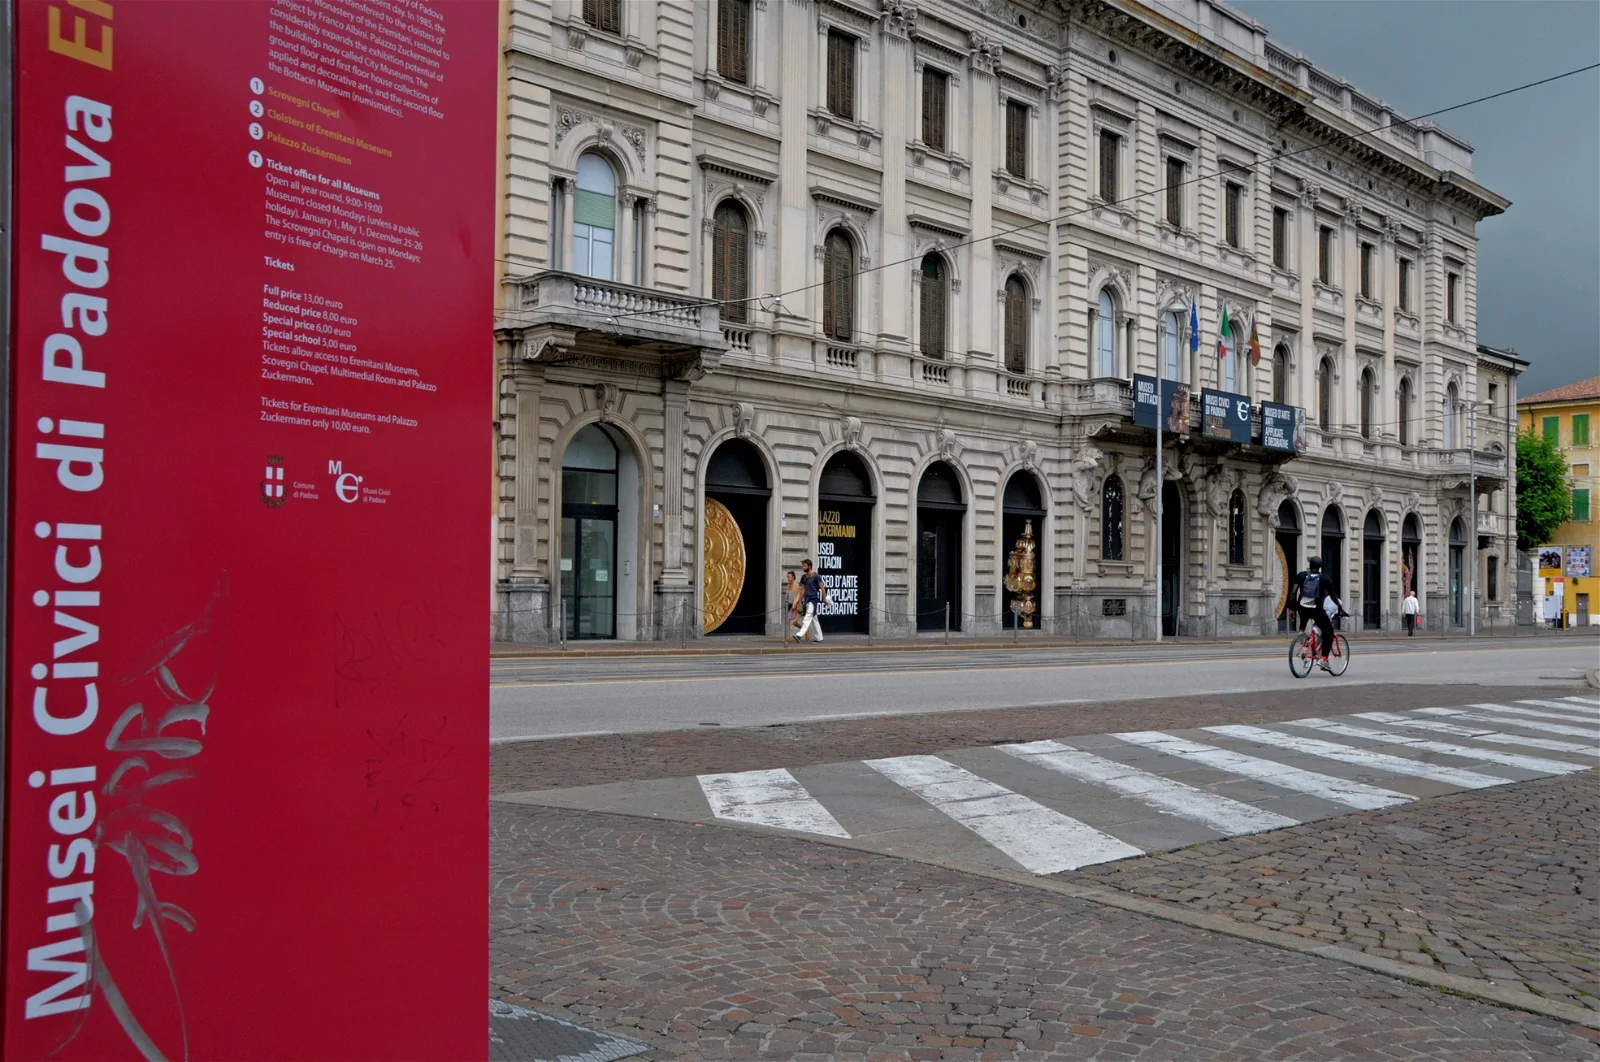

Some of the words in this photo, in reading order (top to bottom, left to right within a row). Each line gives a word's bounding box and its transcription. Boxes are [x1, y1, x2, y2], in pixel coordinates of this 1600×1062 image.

[270, 8, 321, 34] considerably
[321, 29, 354, 46] expands
[354, 41, 368, 52] the
[368, 48, 404, 66] exhibition
[405, 62, 436, 79] potential
[270, 20, 284, 32] the
[284, 26, 322, 48] buildings
[322, 43, 341, 54] now
[340, 50, 364, 64] called
[364, 57, 379, 71] City
[416, 77, 429, 89] The
[268, 62, 282, 73] the
[283, 67, 317, 86] Bottacin
[317, 80, 351, 98] Museum
[269, 36, 299, 52] ground
[300, 45, 319, 59] floor
[320, 55, 336, 66] and
[336, 59, 351, 72] first
[352, 65, 370, 78] floor
[370, 72, 393, 88] house
[393, 84, 430, 102] collections
[269, 50, 299, 66] applied
[300, 62, 316, 72] and
[316, 67, 357, 87] decorative
[374, 89, 389, 99] and
[389, 93, 402, 104] the
[403, 100, 428, 113] second
[428, 107, 444, 119] floor
[268, 86, 310, 108] Scrovegni
[310, 102, 340, 118] Chapel
[267, 109, 305, 128] Cloisters
[305, 123, 315, 132] of
[315, 125, 355, 145] Eremitani
[356, 139, 392, 157] Museums
[267, 131, 300, 148] Palazzo
[301, 142, 352, 165] Zuckermann
[266, 159, 293, 174] Ticket
[294, 169, 317, 181] office
[318, 174, 330, 185] for
[331, 180, 342, 188] all
[343, 182, 380, 200] Museums
[266, 173, 289, 186] Open
[290, 181, 300, 190] all
[301, 185, 319, 195] year
[319, 190, 344, 203] round,
[345, 196, 383, 214] 9:00-19:00
[265, 200, 300, 218] holiday),
[301, 211, 332, 227] January
[334, 219, 340, 229] 1,
[341, 221, 357, 234] May
[359, 226, 365, 236] 1,
[366, 228, 402, 244] December
[404, 238, 423, 250] 25-26
[266, 187, 305, 205] Museums
[305, 199, 331, 212] closed
[332, 206, 366, 222] Mondays
[367, 216, 392, 229] (unless
[398, 226, 419, 237] public
[41, 94, 113, 389] Padova
[264, 231, 287, 243] entry
[288, 234, 295, 244] is
[295, 236, 312, 248] free
[312, 241, 321, 250] of
[322, 244, 348, 258] charge
[361, 253, 384, 265] March
[384, 258, 395, 268] 25.
[266, 214, 281, 226] The
[282, 219, 321, 237] Scrovegni
[322, 230, 349, 243] Chapel
[357, 240, 376, 250] open
[388, 247, 421, 263] Mondays;
[264, 256, 295, 271] Tickets
[263, 284, 279, 295] Full
[280, 290, 302, 300] price
[304, 293, 324, 305] 13,00
[325, 300, 343, 309] euro
[263, 299, 300, 314] Reduced
[301, 308, 322, 318] price
[322, 311, 339, 322] 8,00
[340, 316, 357, 325] euro
[262, 327, 293, 340] Special
[294, 334, 321, 345] school
[322, 338, 338, 348] 5,00
[339, 343, 357, 352] euro
[263, 313, 293, 326] Special
[294, 321, 315, 330] price
[316, 324, 333, 334] 6,00
[334, 328, 351, 337] euro
[262, 355, 299, 370] Scovegni
[300, 361, 329, 374] Chapel,
[330, 367, 374, 381] Multimedial
[375, 374, 397, 384] Room
[397, 379, 411, 387] and
[412, 380, 437, 392] Palazzo
[263, 340, 290, 354] Tickets
[291, 346, 313, 357] allow
[314, 352, 339, 362] access
[340, 355, 349, 364] to
[349, 356, 384, 369] Eremitani
[384, 362, 419, 376] Museums,
[261, 369, 314, 385] Zuckermann.
[260, 411, 311, 425] Zuckermann
[312, 419, 329, 430] only
[332, 421, 352, 431] 10,00
[352, 425, 371, 433] euro.
[262, 397, 289, 409] Tickets
[290, 401, 302, 411] for
[303, 403, 340, 416] Eremitani
[341, 408, 376, 421] Museums
[377, 415, 391, 423] and
[392, 415, 418, 426] Palazzo
[36, 417, 105, 493] di
[818, 510, 840, 524] LAZZO
[835, 575, 858, 588] D'ARTE
[31, 521, 102, 735] Civici
[25, 766, 98, 1020] Musei
